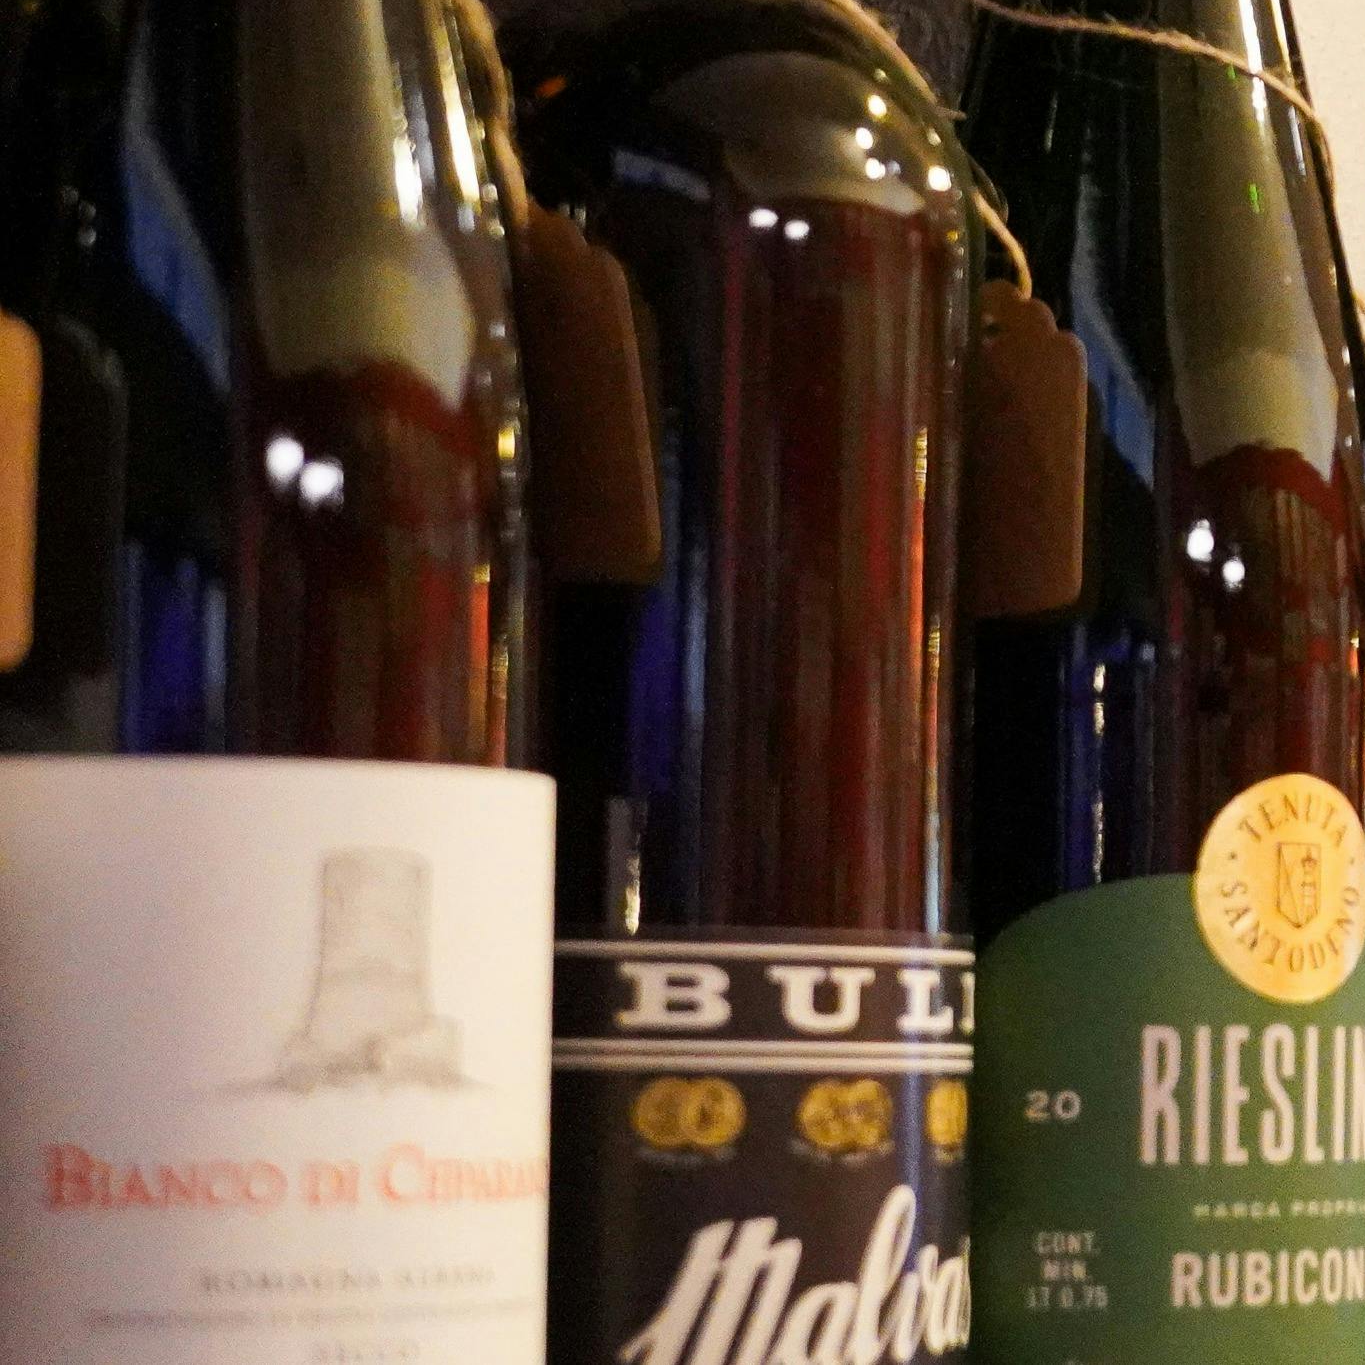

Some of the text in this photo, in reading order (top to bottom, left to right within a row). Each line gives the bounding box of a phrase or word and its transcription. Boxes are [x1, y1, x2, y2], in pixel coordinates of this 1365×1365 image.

[1237, 791, 1348, 849] TENUTA
[1024, 1090, 1081, 1124] 20
[46, 1141, 289, 1212] BIANCO
